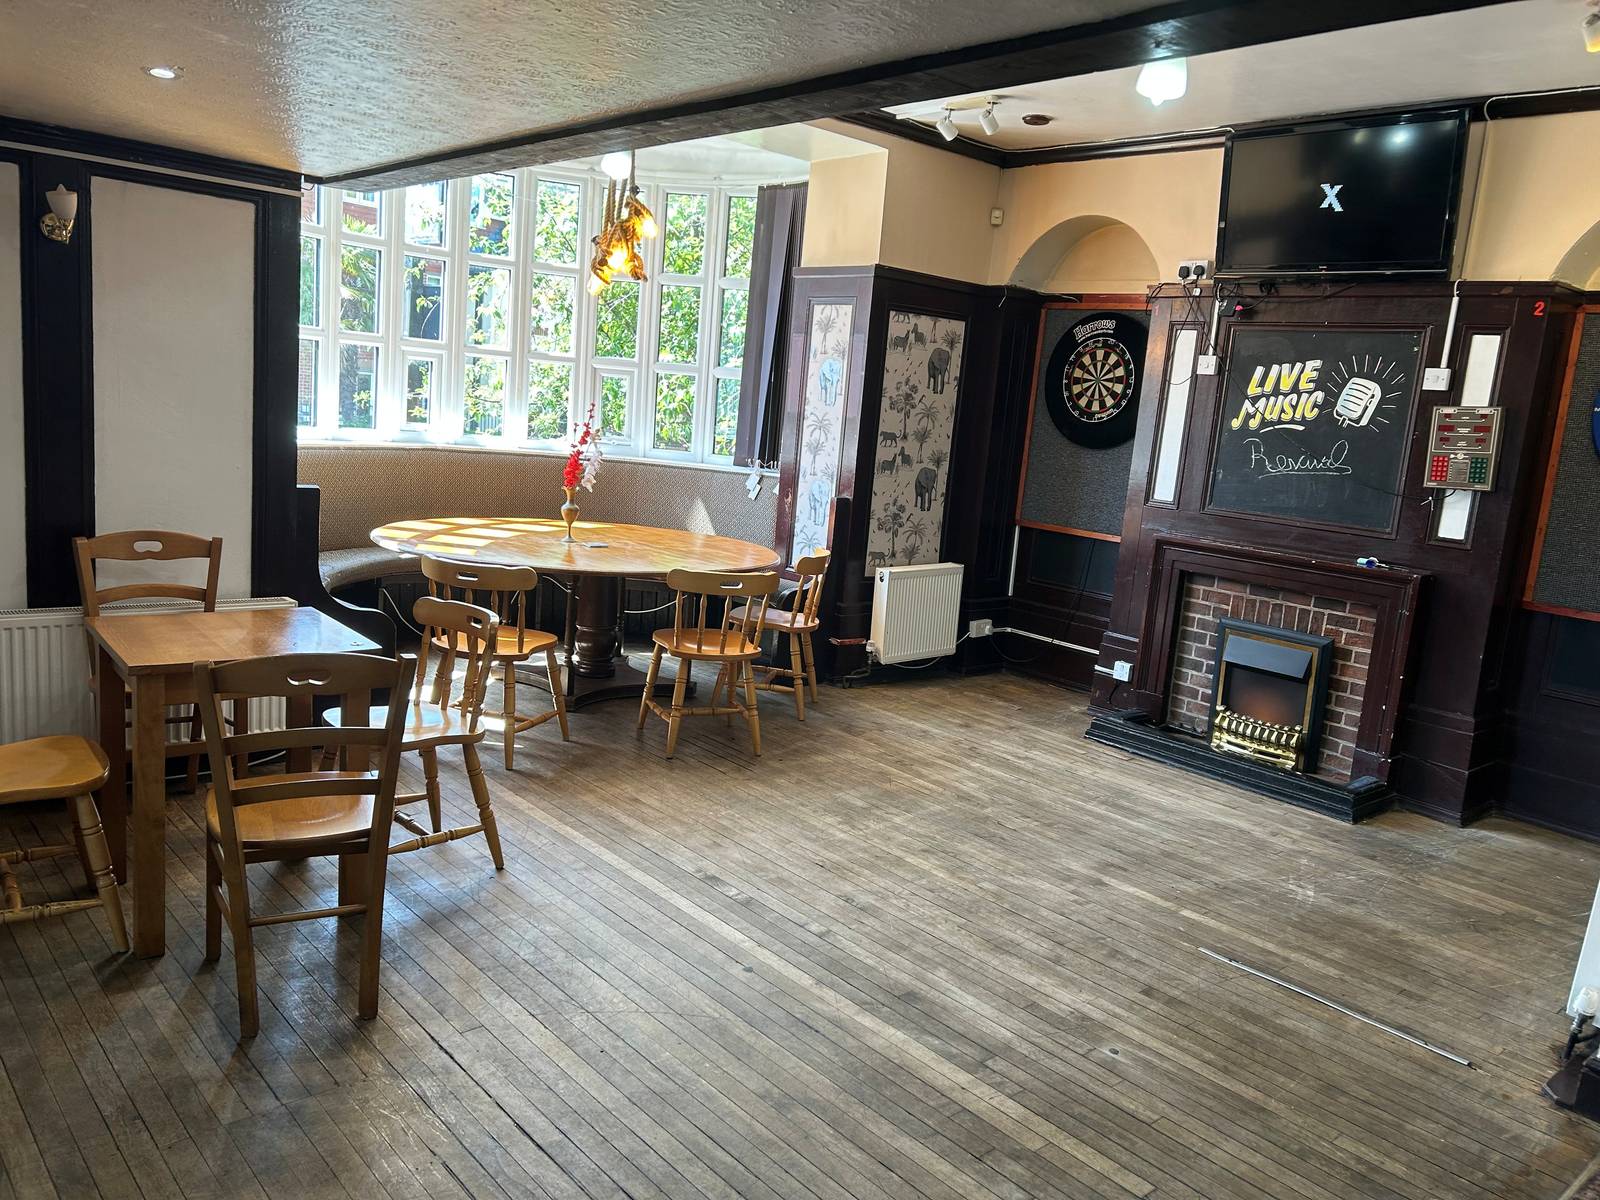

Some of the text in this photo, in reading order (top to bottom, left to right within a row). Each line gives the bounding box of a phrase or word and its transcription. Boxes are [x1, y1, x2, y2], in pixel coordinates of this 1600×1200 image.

[1319, 183, 1344, 212] X
[1532, 301, 1545, 317] 2
[1073, 319, 1116, 340] Harrows
[1247, 359, 1323, 398] LIVE
[1231, 390, 1325, 431] MUSIC
